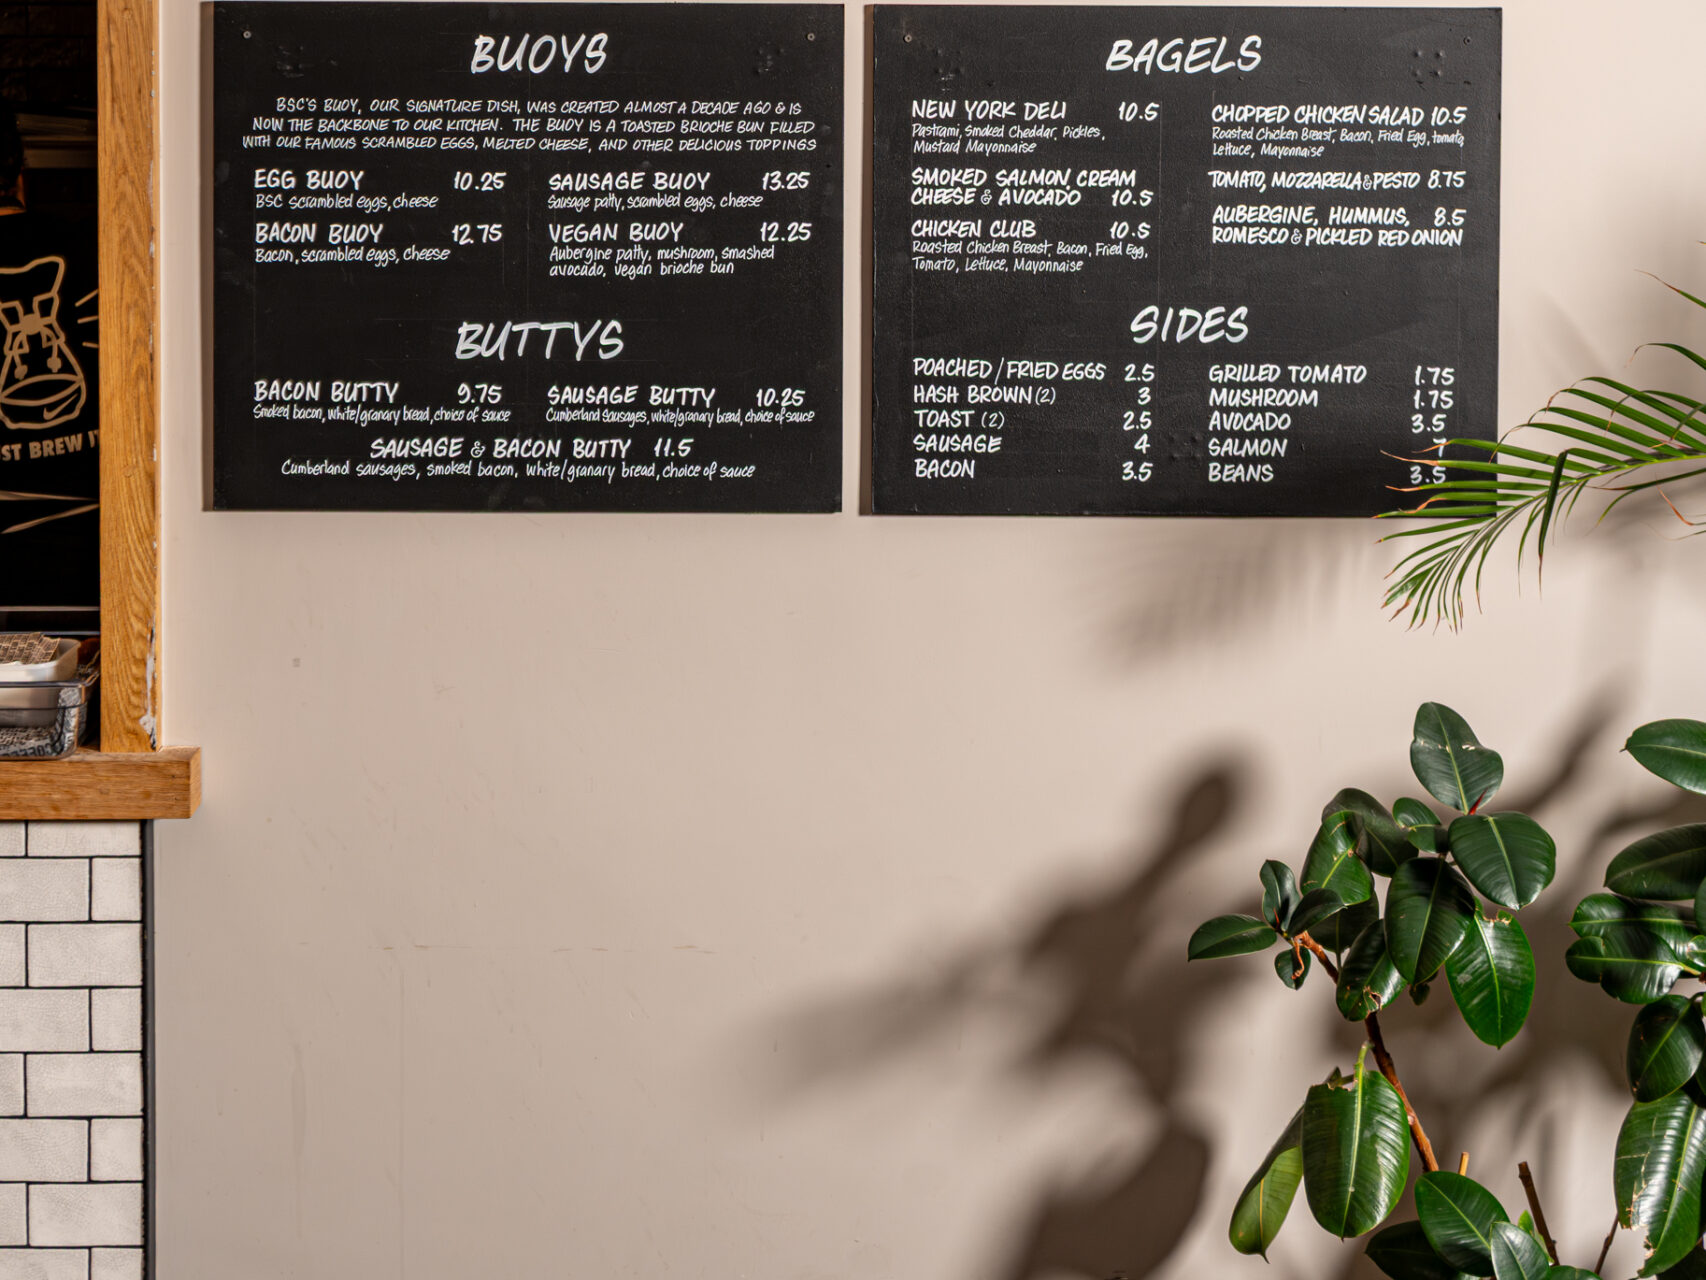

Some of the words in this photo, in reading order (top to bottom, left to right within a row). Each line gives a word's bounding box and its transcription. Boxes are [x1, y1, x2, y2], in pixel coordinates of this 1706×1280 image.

[470, 32, 609, 75] BUOYS
[1105, 34, 1262, 76] BAGELS
[276, 96, 317, 113] BSC'S
[369, 98, 401, 112] OUR
[405, 98, 484, 113] SIGNATURE
[526, 100, 557, 114] WAS
[560, 99, 620, 114] CREATED
[623, 100, 679, 115] ALMOST
[676, 101, 688, 115] A
[690, 100, 741, 116] DECADE
[742, 100, 772, 116] AGO
[774, 101, 787, 115] &
[788, 102, 802, 116] IS
[911, 98, 957, 120] NEW
[964, 99, 1017, 122] YORK
[1023, 100, 1067, 122] DELI
[1118, 100, 1160, 123] 10.5
[964, 123, 1005, 138] Smoked
[913, 139, 963, 155] Mustard
[964, 138, 1038, 157] Mayonnaise
[253, 167, 297, 190] EGG
[305, 169, 365, 191] BUOY
[453, 170, 508, 192] 10.25
[548, 171, 646, 192] SAUSAGE
[652, 171, 711, 191] BUOY
[761, 170, 811, 192] 13.25
[1211, 204, 1319, 227] AUBERGINE,
[1328, 205, 1411, 228] HUMMUS,
[1433, 206, 1467, 228] 8.5
[254, 221, 318, 244] BACON
[328, 223, 384, 245] BUOY
[451, 222, 503, 246] 12.75
[548, 222, 619, 244] VEGAN
[628, 221, 685, 243] BUOY
[759, 221, 813, 243] 12.25
[910, 218, 983, 239] CHICKEN
[989, 218, 1037, 239] CLUB
[1109, 220, 1152, 240] 10.5
[1211, 226, 1290, 245] ROMESCO
[1290, 227, 1303, 246] &
[1304, 226, 1374, 247] PICKLED
[1377, 229, 1411, 248] RED
[1410, 228, 1464, 247] ONION
[614, 264, 653, 281] vegan
[659, 260, 705, 276] brioche
[709, 259, 735, 274] bun
[1129, 304, 1249, 344] SIDES
[454, 318, 625, 362] BUTTYS
[1208, 362, 1282, 384] GRILLED
[1287, 363, 1368, 385] TOMATO
[1414, 364, 1455, 386] 1.75
[253, 378, 321, 402] BACON
[330, 380, 400, 404] BUTTY
[457, 382, 503, 405] 9.75
[547, 384, 640, 406] SAUSAGE
[648, 384, 716, 409] BUTTY
[755, 387, 806, 407] 10.25
[913, 384, 960, 404] HASH
[967, 384, 1033, 405] BROWN
[1034, 385, 1057, 406] (2)
[1137, 386, 1152, 406] 3
[1208, 387, 1319, 408] MUSHROOM
[1413, 388, 1454, 410] 1.75
[913, 408, 976, 429] TOAST
[980, 410, 1005, 430] (2)
[1122, 410, 1153, 432] 2.5
[1208, 409, 1292, 432] AVOCADO
[1410, 413, 1447, 434] 3.5
[1, 443, 22, 462] ST
[28, 432, 83, 460] BREW
[912, 432, 1003, 454] SAUSAGE
[1133, 432, 1151, 455] 4
[1207, 437, 1289, 458] SALMON
[1432, 437, 1447, 458] 7
[913, 457, 976, 480] BACON
[1121, 460, 1154, 483] 3.5
[1207, 461, 1275, 483] BEANS
[1410, 465, 1447, 485] 3.5
